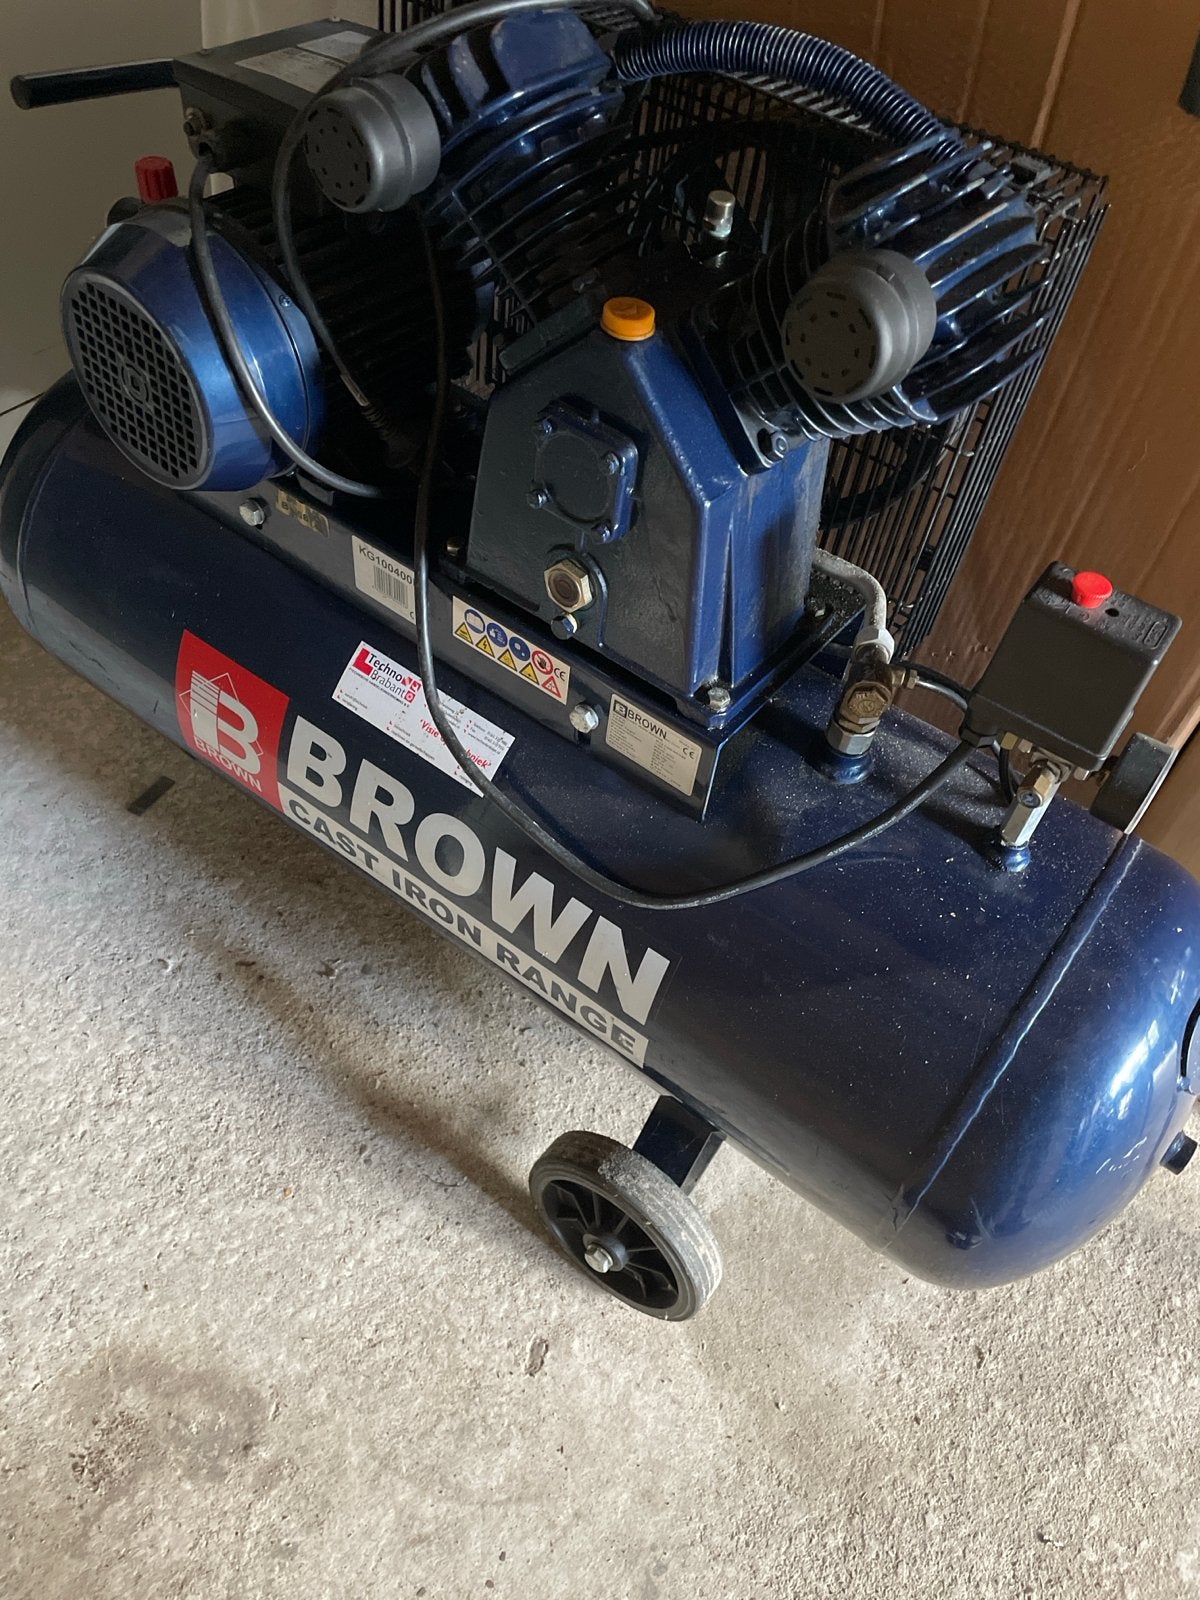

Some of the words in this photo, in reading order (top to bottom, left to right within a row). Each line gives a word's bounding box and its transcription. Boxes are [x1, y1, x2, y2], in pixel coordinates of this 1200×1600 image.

[368, 653, 402, 682] Techno
[369, 669, 405, 698] Brabant
[627, 709, 667, 740] BROWN
[194, 735, 262, 793] BROWN
[286, 716, 670, 1025] BROWN
[288, 799, 379, 871] CAST
[391, 868, 481, 947] IRON
[496, 941, 636, 1054] RANGE
